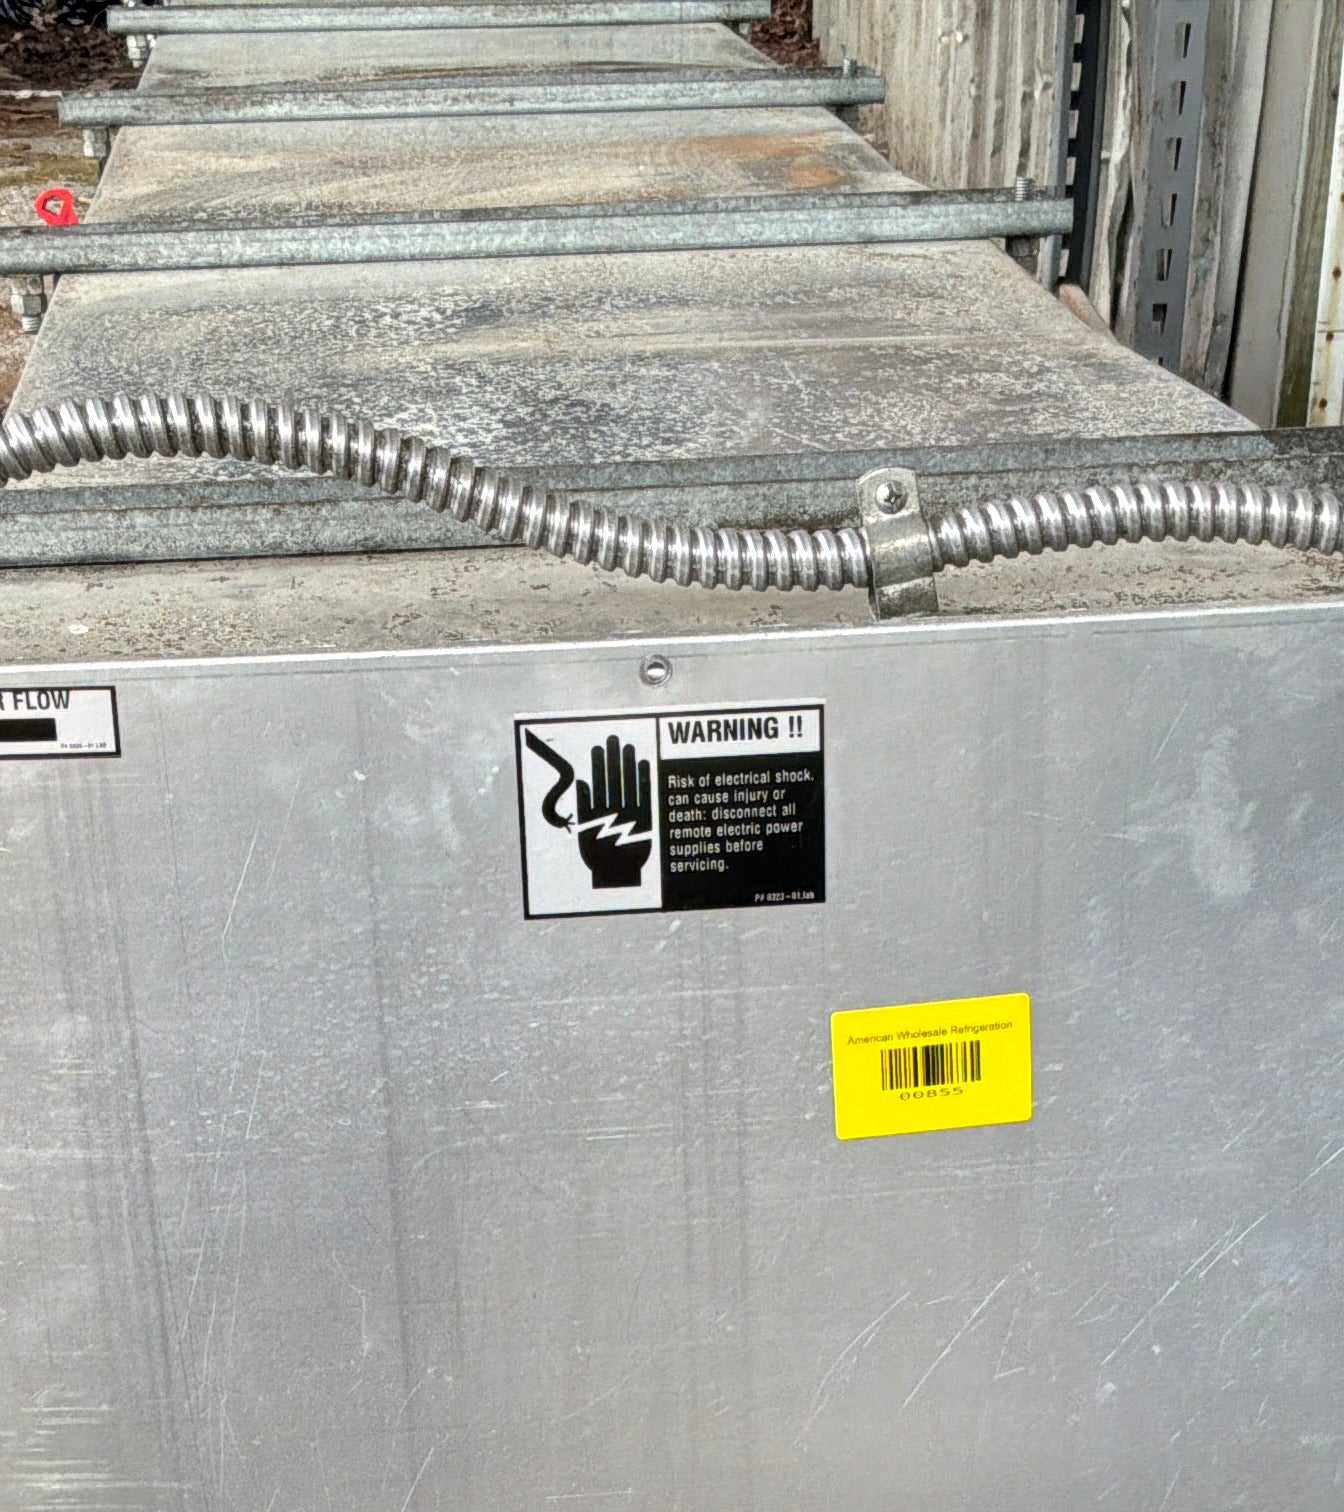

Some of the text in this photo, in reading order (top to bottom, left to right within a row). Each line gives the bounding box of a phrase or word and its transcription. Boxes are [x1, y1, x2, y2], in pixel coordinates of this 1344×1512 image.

[13, 690, 70, 710] FLOW
[668, 715, 803, 743] WARNING !!
[668, 774, 694, 789] Risk
[699, 773, 710, 787] of
[715, 770, 770, 786] electrical
[668, 788, 786, 806] can cause injury or
[712, 805, 777, 820] disconnect
[782, 802, 796, 816] all
[670, 820, 803, 839] remote electric power
[670, 838, 763, 857] supplies before
[670, 857, 729, 873] servicing.
[847, 1021, 1013, 1046] American Wholesale Refrigeration
[900, 1087, 964, 1101] 00855
